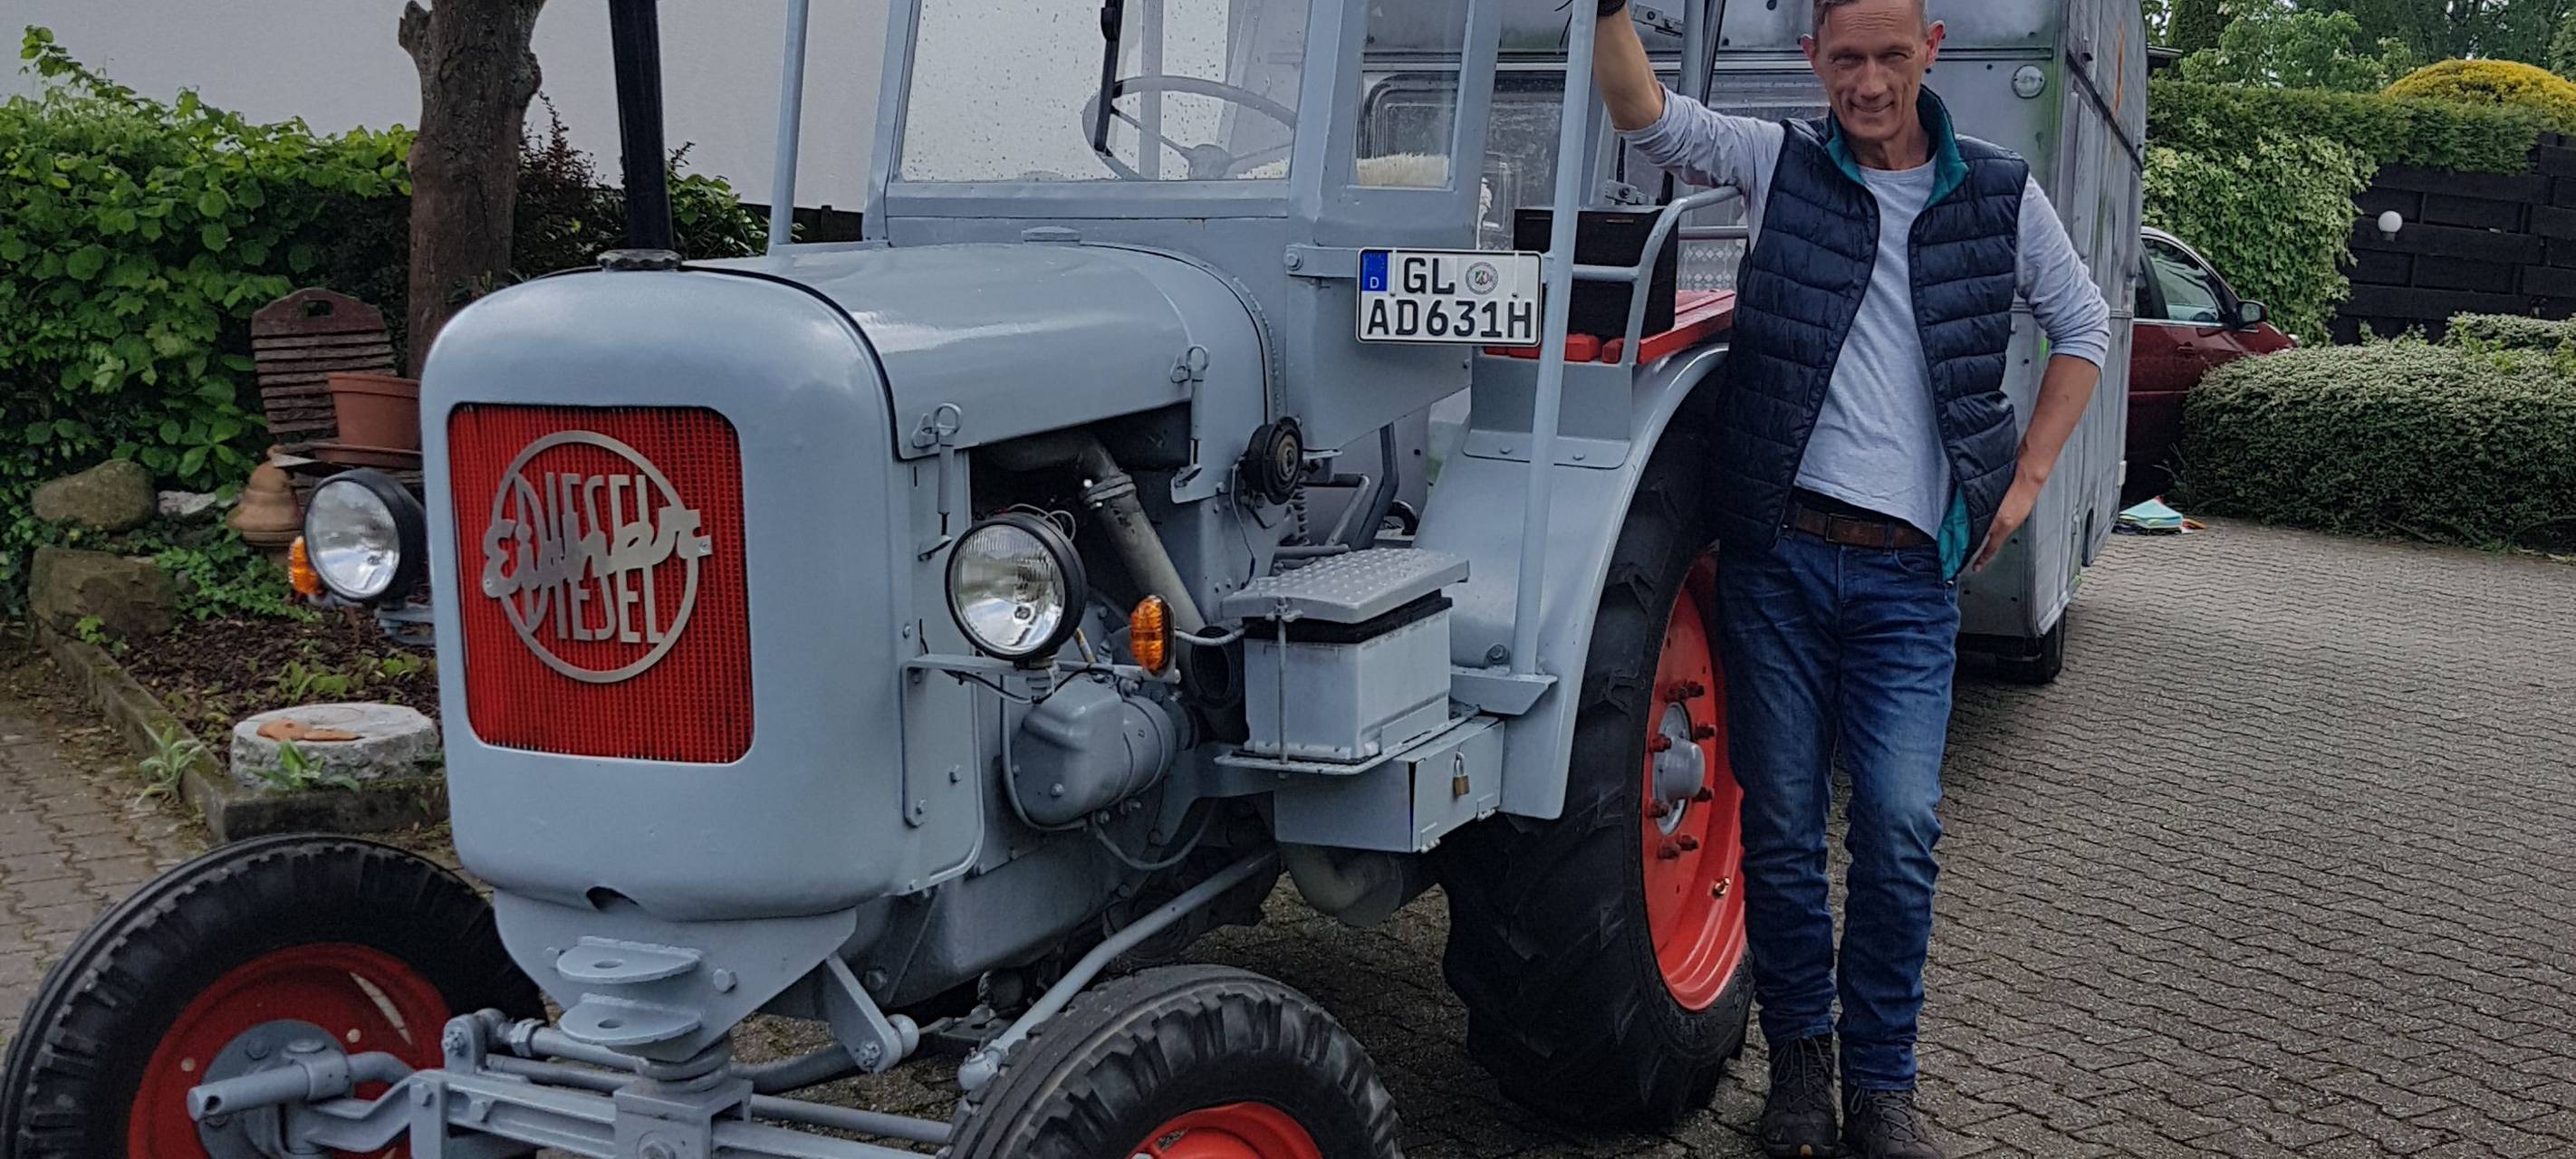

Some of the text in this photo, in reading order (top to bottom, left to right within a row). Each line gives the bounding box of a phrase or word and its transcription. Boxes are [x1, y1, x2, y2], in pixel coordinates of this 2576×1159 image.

[1369, 276, 1380, 290] D
[1403, 257, 1456, 294] GL
[1367, 299, 1533, 339] AD631H
